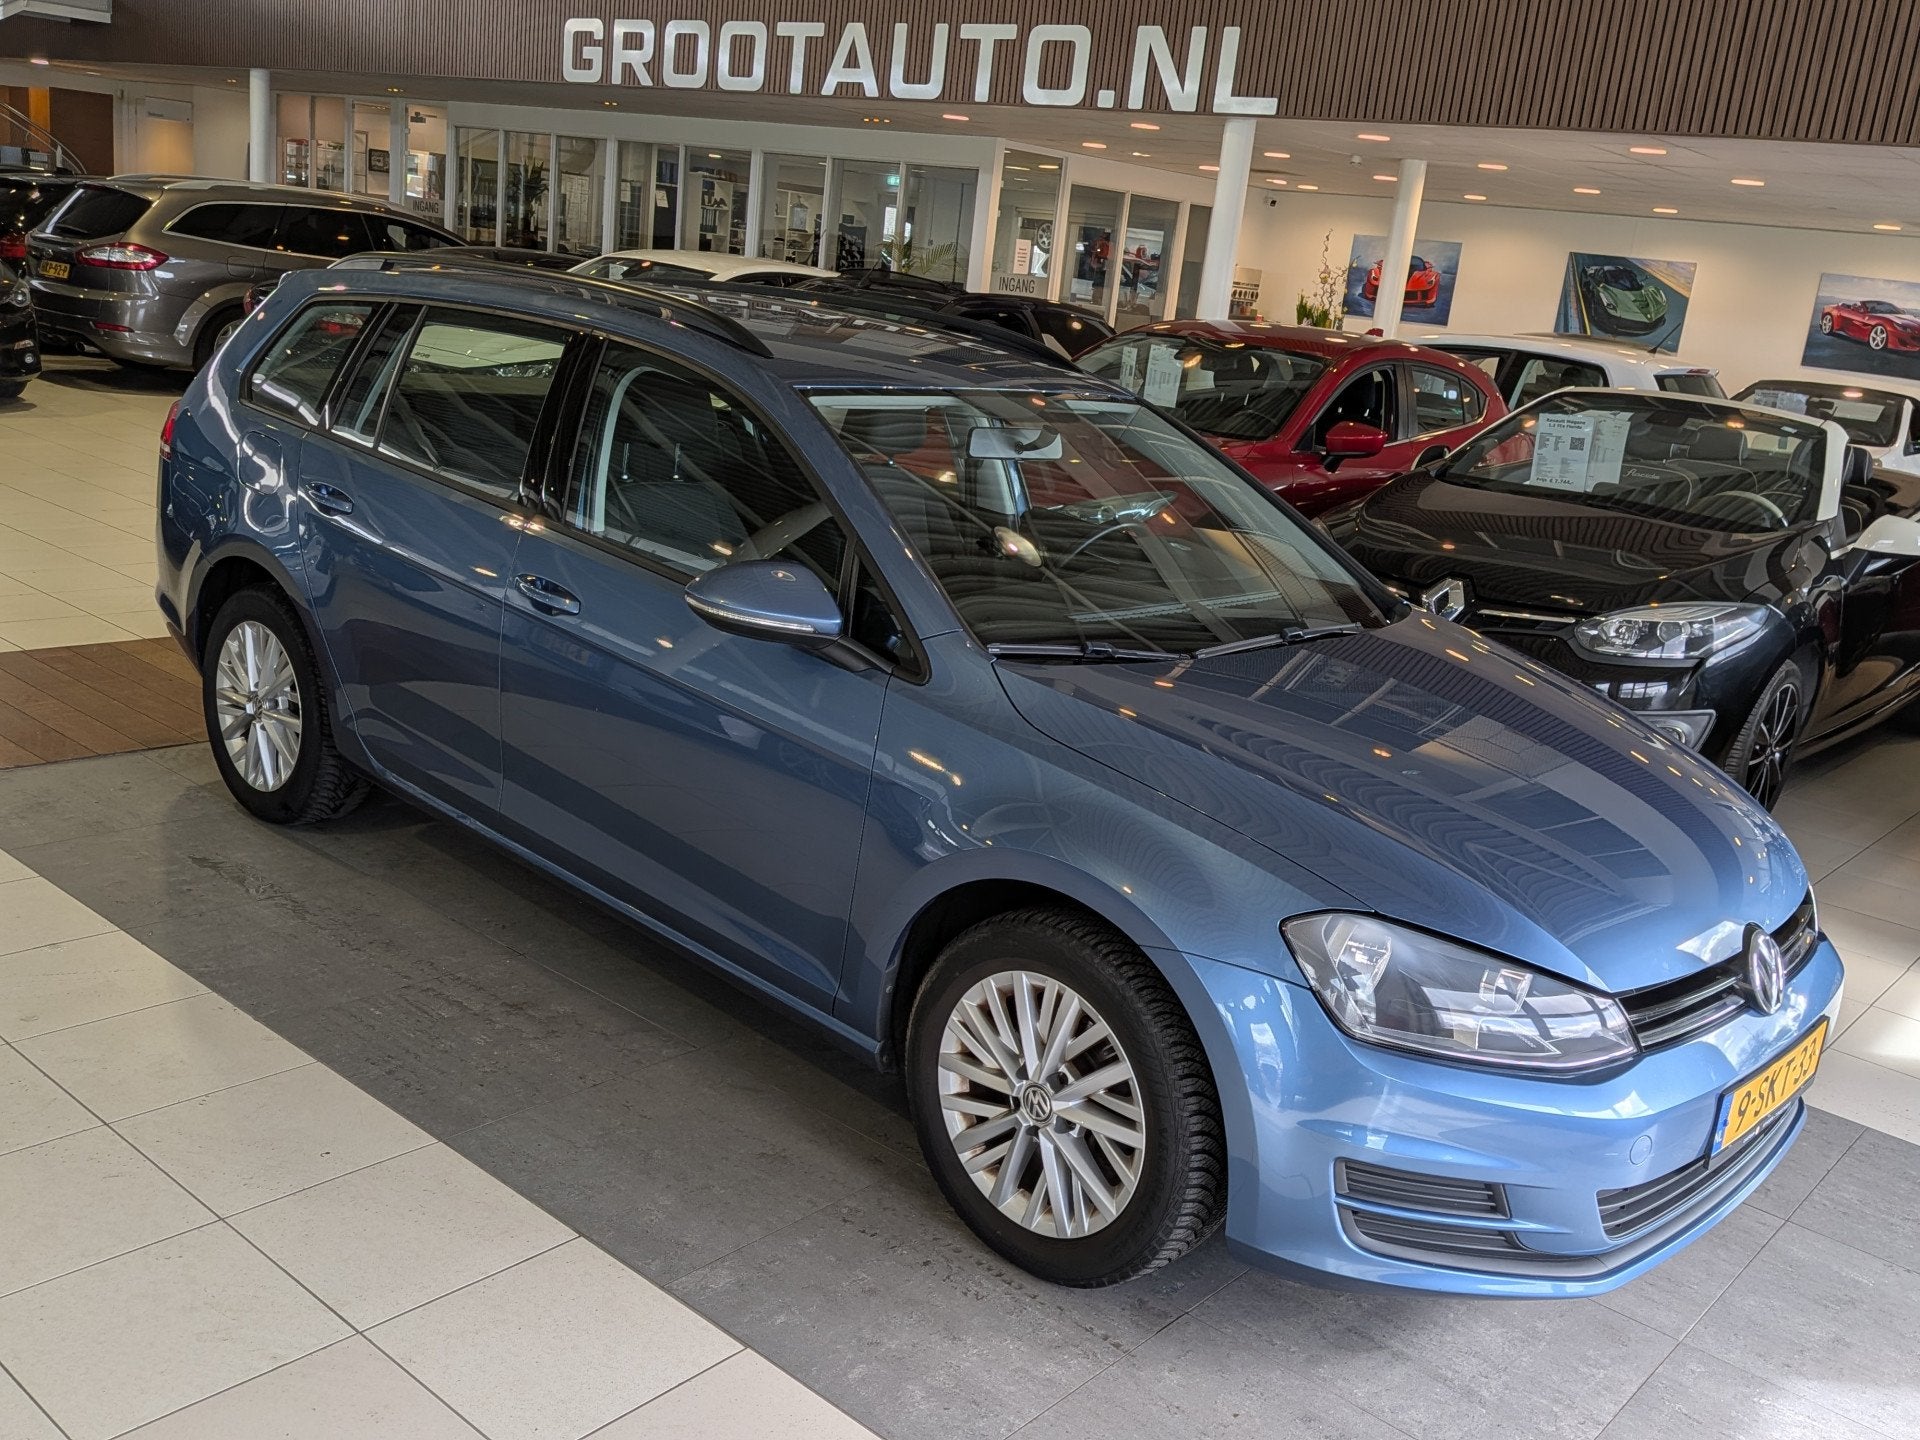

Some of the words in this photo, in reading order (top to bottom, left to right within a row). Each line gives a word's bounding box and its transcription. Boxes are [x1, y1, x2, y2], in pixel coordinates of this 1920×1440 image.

[562, 17, 1278, 116] GROOTAUTO.NL
[412, 200, 439, 213] INGANG
[998, 276, 1035, 293] INGANG
